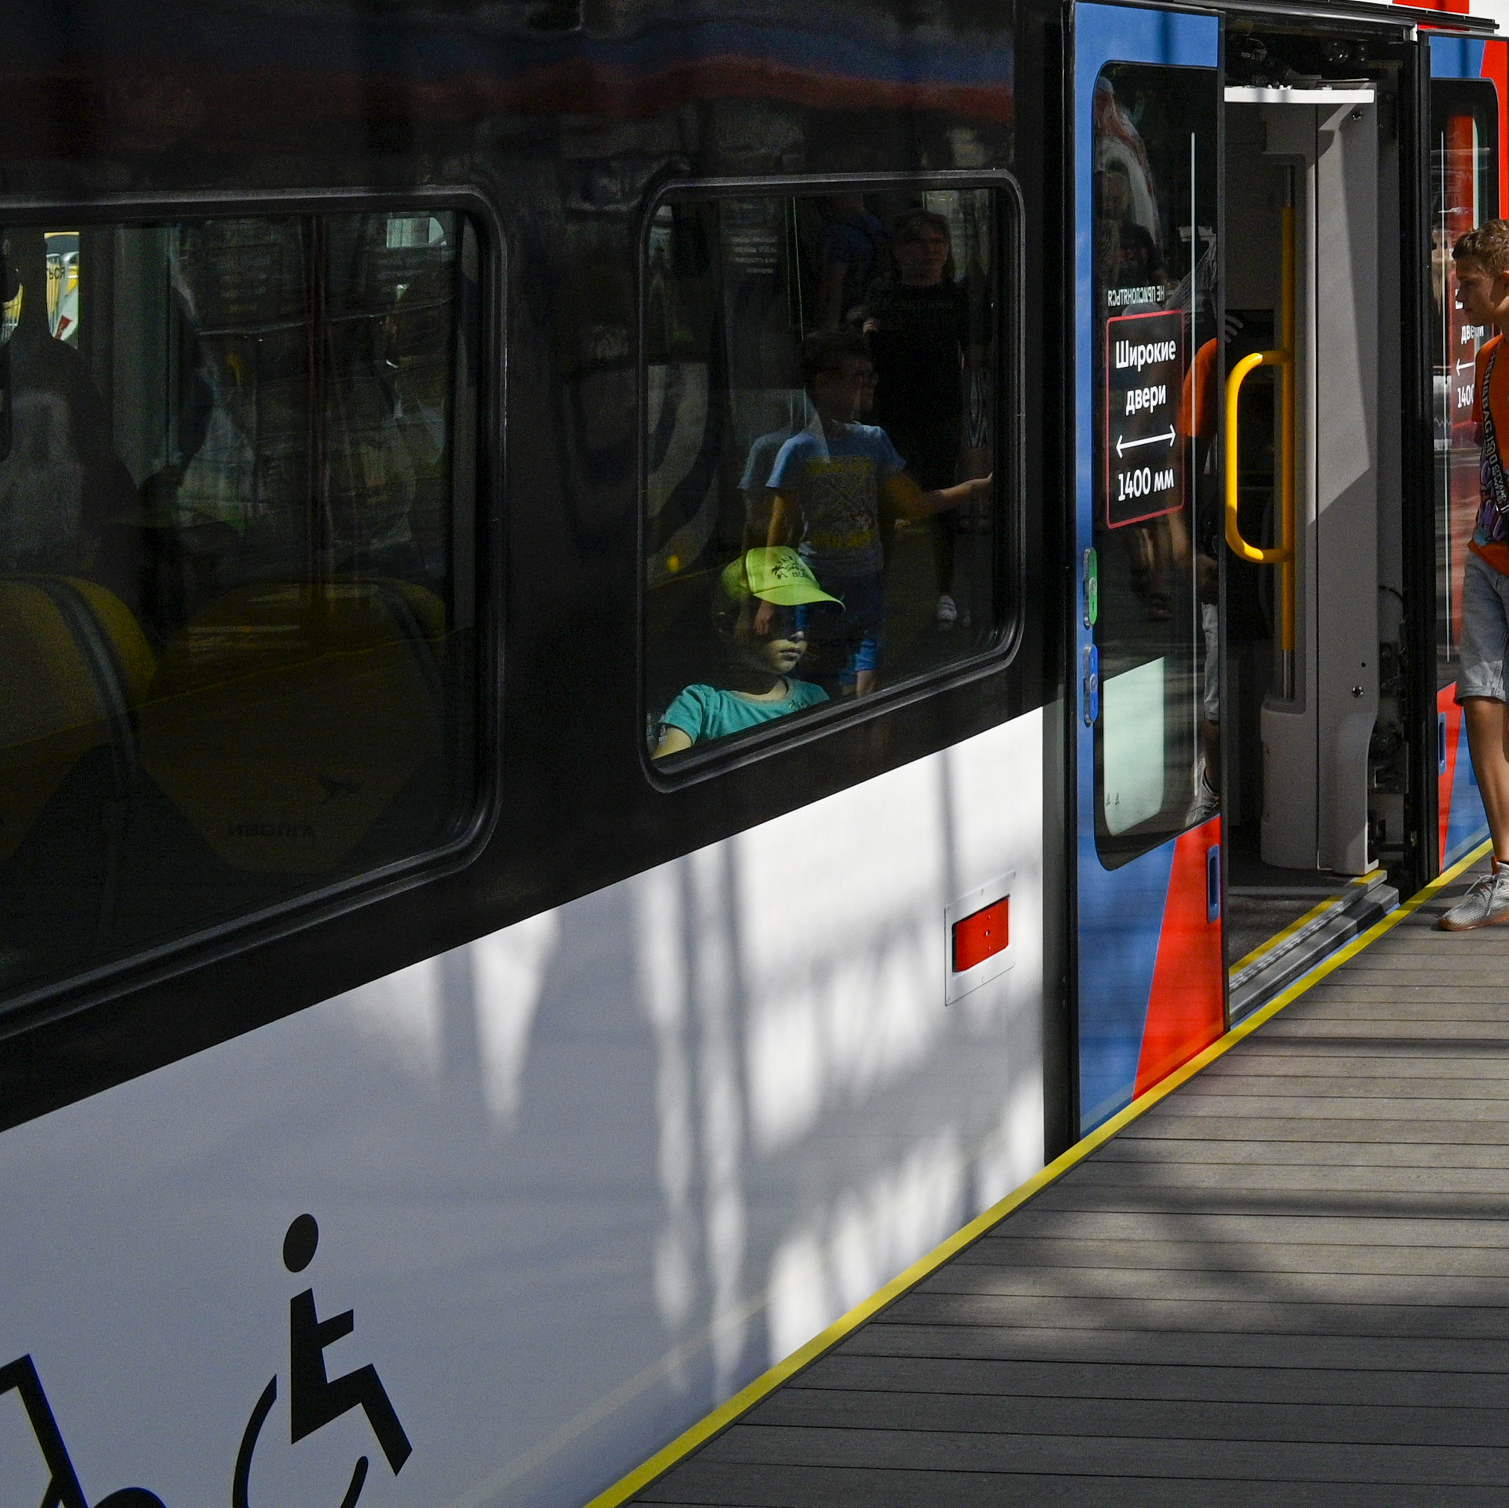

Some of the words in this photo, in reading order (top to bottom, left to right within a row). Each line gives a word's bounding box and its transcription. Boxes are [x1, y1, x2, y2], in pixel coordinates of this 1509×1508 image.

[1115, 339, 1177, 372] Широкие
[1125, 384, 1166, 416] двери
[1118, 466, 1151, 501] 1400
[1154, 468, 1175, 492] мм
